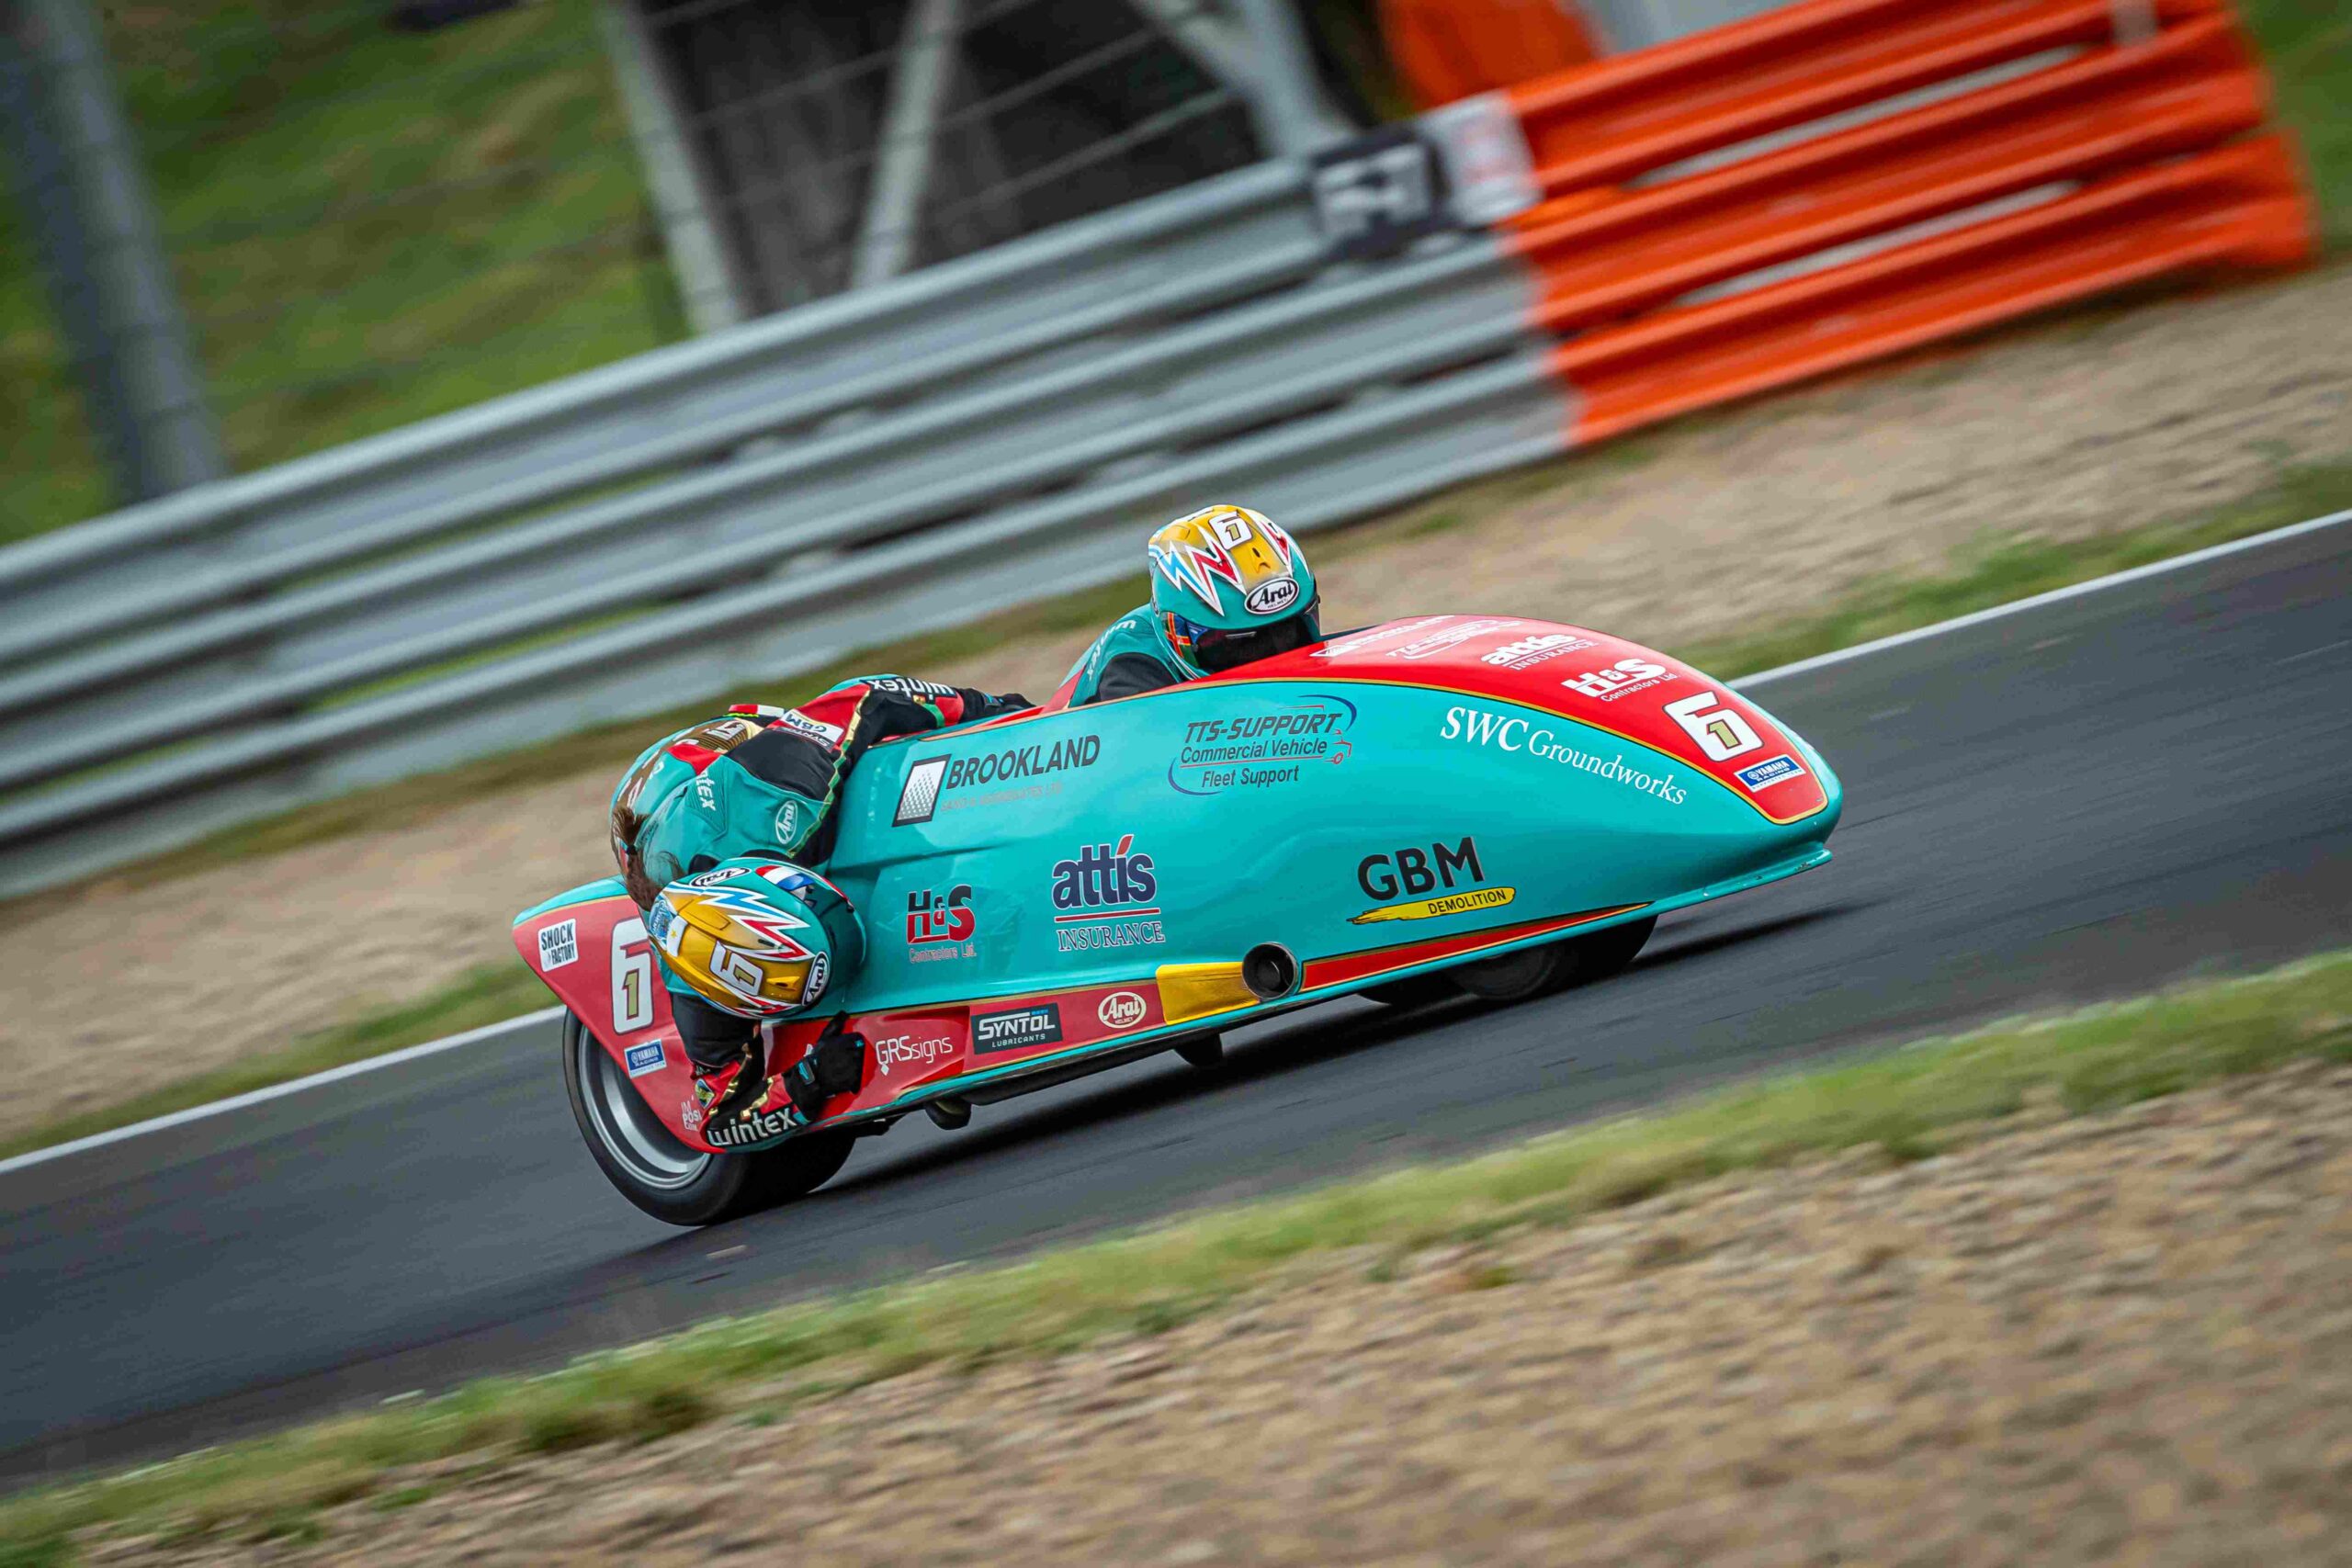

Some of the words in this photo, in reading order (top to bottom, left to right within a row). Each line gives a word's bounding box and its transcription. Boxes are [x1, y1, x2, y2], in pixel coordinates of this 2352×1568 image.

[1250, 581, 1294, 611] Arai
[1480, 633, 1577, 666] attis
[1509, 639, 1600, 671] INSURANCE
[866, 677, 956, 701] wintex
[1561, 658, 1667, 698] H&S
[1600, 679, 1661, 703] Contractors
[786, 713, 829, 734] GBM
[1184, 713, 1343, 744] TTS-SUPPORT
[945, 734, 1101, 790] BROOKLAND
[1181, 740, 1269, 764] Commercial
[1272, 738, 1329, 758] Vehicle
[1440, 706, 1530, 752] SWC
[1528, 729, 1688, 806] Groundworks
[1201, 769, 1237, 789] Fleet
[1240, 765, 1300, 789] Support
[1755, 760, 1789, 776] YAMAHA
[776, 805, 796, 840] Arai
[1052, 834, 1157, 910] attis
[1357, 836, 1486, 901] GBM
[906, 884, 977, 945] H&S
[1427, 888, 1507, 916] DEMOLITION
[540, 922, 574, 952] SHOCK
[1057, 920, 1165, 953] INSURANCE
[550, 942, 576, 965] FACTORY
[909, 944, 958, 964] Contractors
[805, 959, 826, 1004] Arai
[1102, 997, 1141, 1021] Arai
[978, 1010, 1057, 1041] SYNTOL
[991, 1032, 1046, 1048] LUBRICANTS
[707, 1107, 797, 1146] wintex
